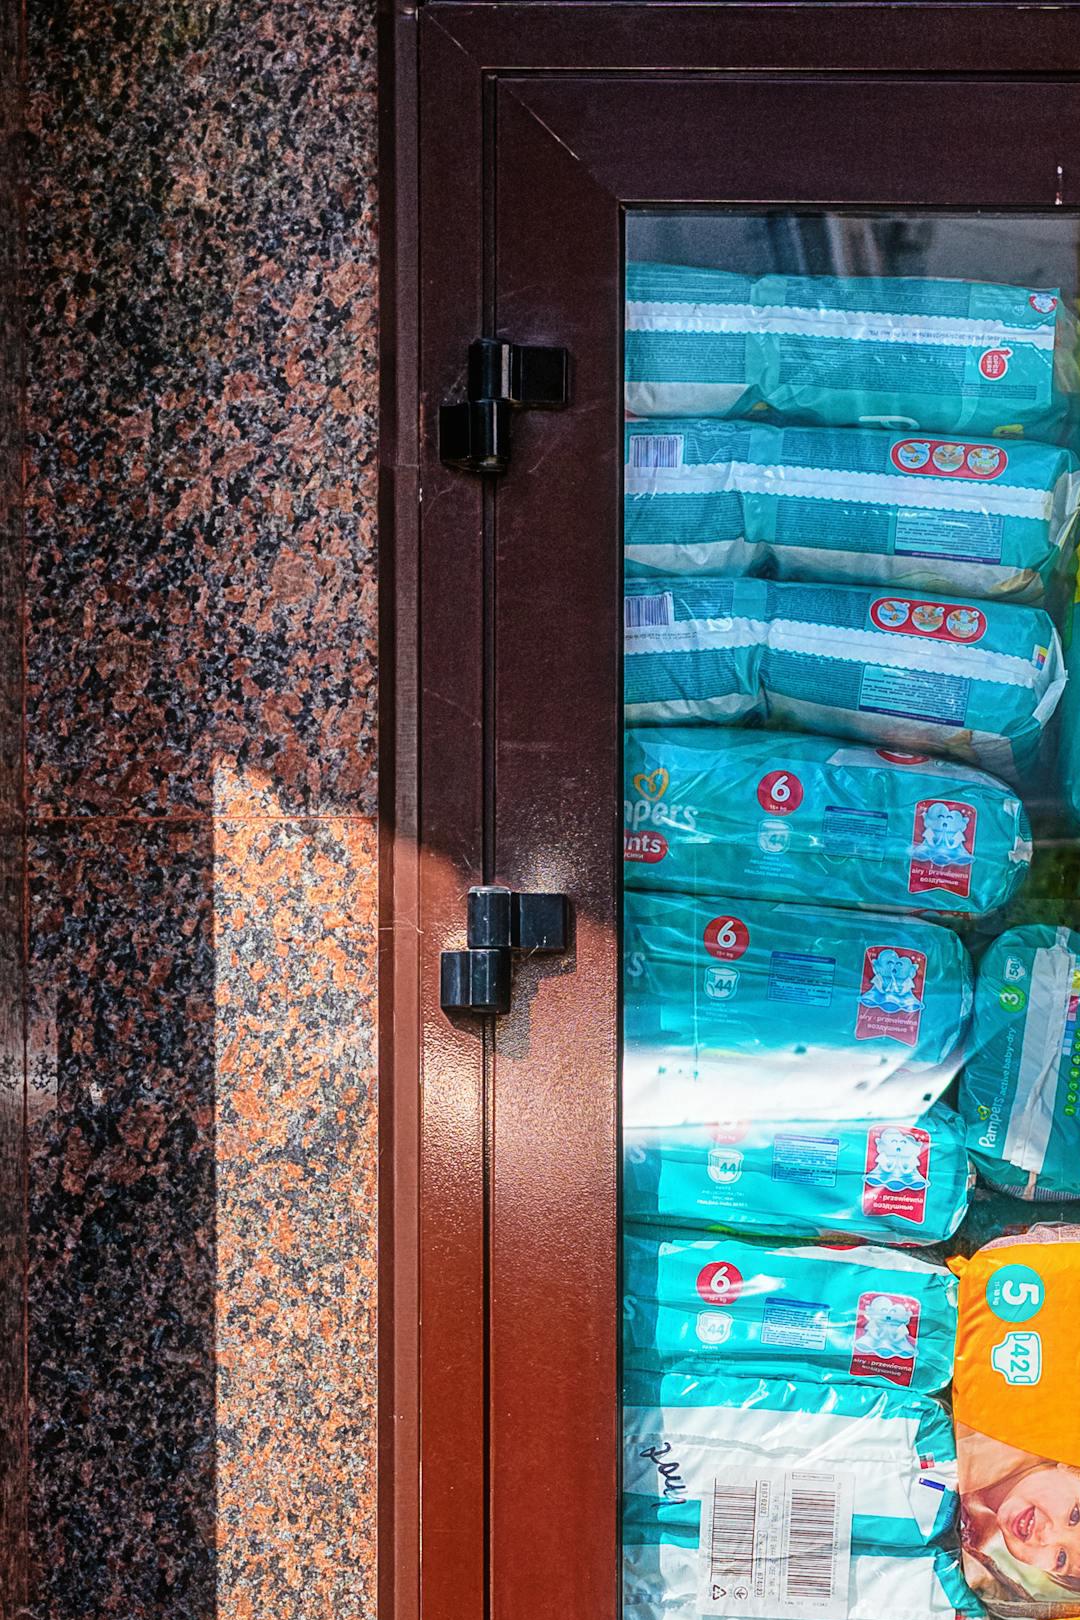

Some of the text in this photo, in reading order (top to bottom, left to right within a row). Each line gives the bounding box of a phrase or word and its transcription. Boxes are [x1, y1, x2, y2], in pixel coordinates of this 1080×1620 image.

[771, 775, 790, 802] 6
[717, 920, 736, 948] 6
[1008, 962, 1020, 977] 58
[714, 979, 732, 991] 44
[1001, 991, 1019, 1006] 3
[979, 1097, 1003, 1149] Pampers
[720, 1161, 736, 1175] 44
[711, 1266, 731, 1294] 6
[1001, 1280, 1040, 1373] 5 42
